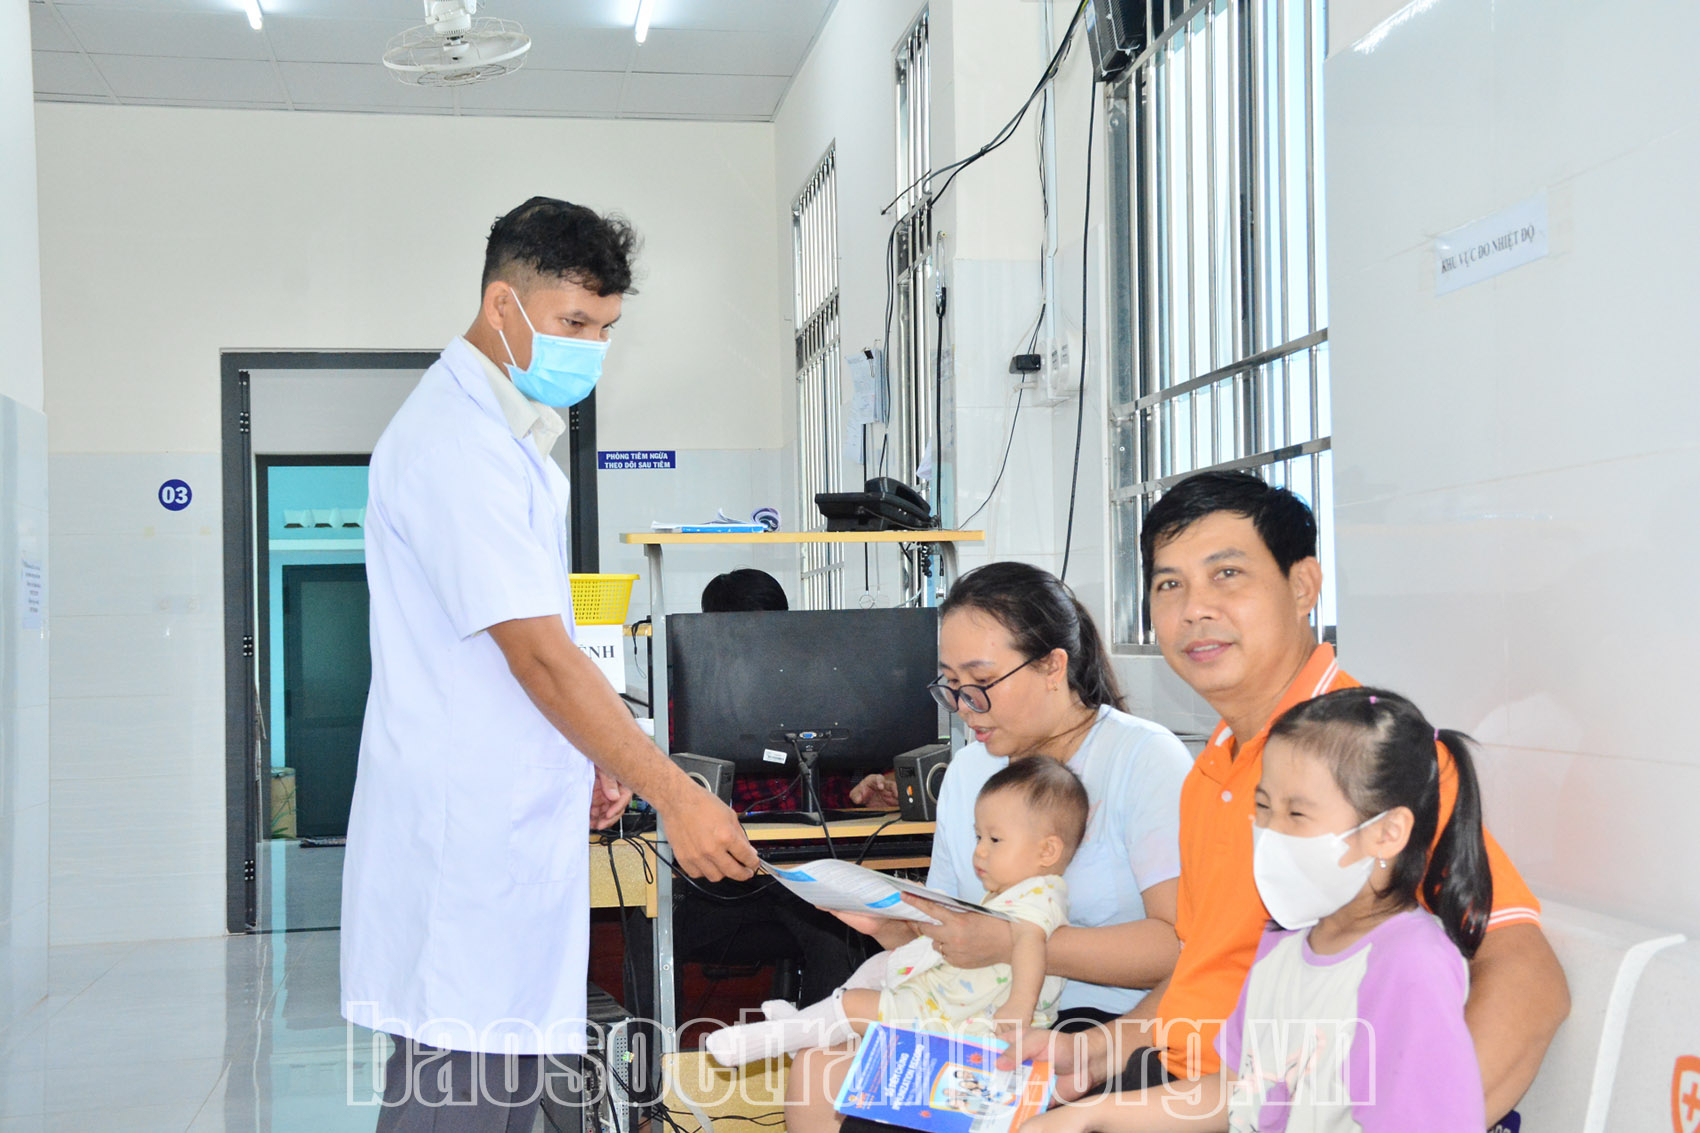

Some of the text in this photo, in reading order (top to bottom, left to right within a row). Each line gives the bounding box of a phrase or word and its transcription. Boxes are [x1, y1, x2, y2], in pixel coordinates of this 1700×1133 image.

[1441, 256, 1457, 274] KHU
[606, 452, 629, 460] PHÒNG
[631, 452, 648, 460] TIÊM
[638, 461, 652, 469] SAU
[161, 486, 189, 504] 03
